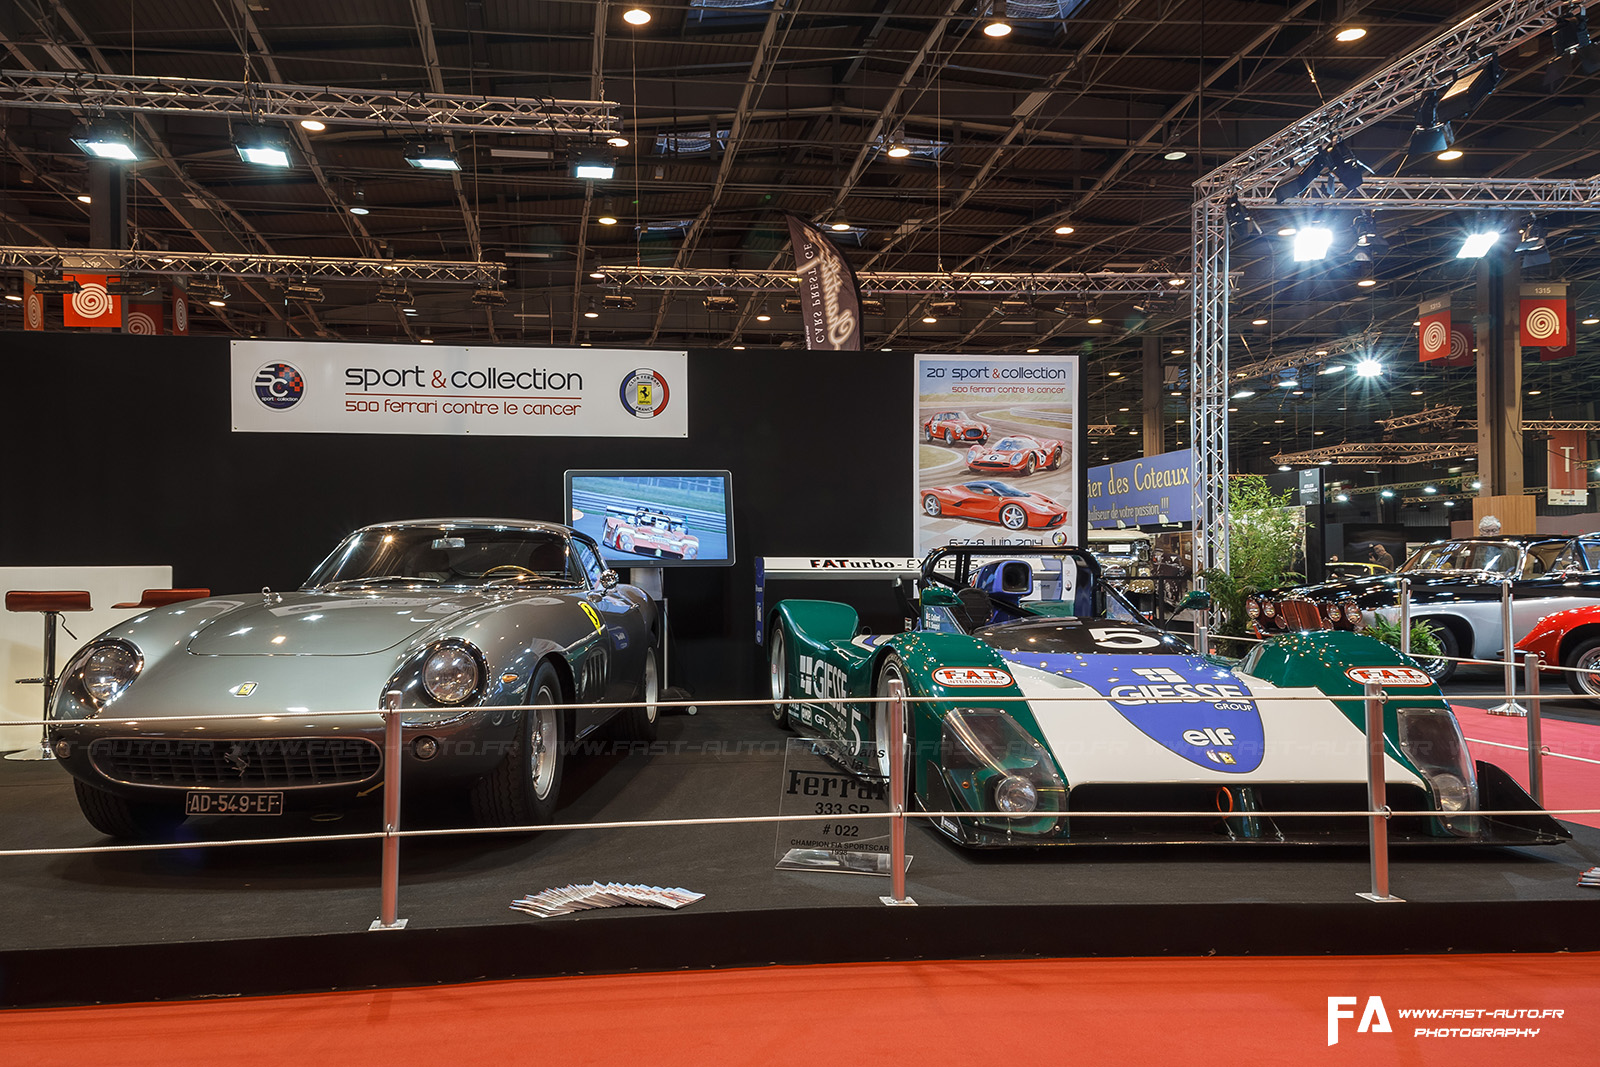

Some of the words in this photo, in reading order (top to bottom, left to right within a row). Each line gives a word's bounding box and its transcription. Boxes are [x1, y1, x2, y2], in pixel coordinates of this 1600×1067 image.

[345, 365, 426, 391] sport
[432, 370, 447, 388] &
[450, 367, 583, 390] collection
[952, 367, 989, 380] sport
[992, 369, 1000, 378] &
[1001, 367, 1066, 379] collection
[346, 400, 380, 413] 500
[384, 399, 438, 414] ferrari
[442, 401, 499, 415] contre
[503, 401, 518, 415] le
[522, 402, 582, 416] cancer
[1560, 446, 1574, 472] T
[1088, 480, 1103, 498] ier
[1108, 467, 1129, 495] des
[1134, 463, 1190, 491] Coteaux
[1110, 502, 1118, 519] de
[1118, 505, 1134, 518] votre
[1134, 503, 1160, 523] passion
[1090, 628, 1161, 647] 5
[813, 659, 848, 718] GIESSE
[1110, 684, 1244, 706] GIESSE
[1214, 702, 1253, 712] GROUP
[851, 708, 862, 756] 5
[1183, 727, 1236, 747] elf
[811, 743, 835, 755] Les
[838, 746, 855, 757] 20
[859, 748, 885, 759] ans
[190, 794, 278, 812] AD-549-EF
[815, 802, 842, 815] 333
[822, 824, 831, 834] #
[835, 825, 859, 837] 022
[790, 839, 829, 848] CHAMPION
[844, 843, 889, 851] SPORTSCAR
